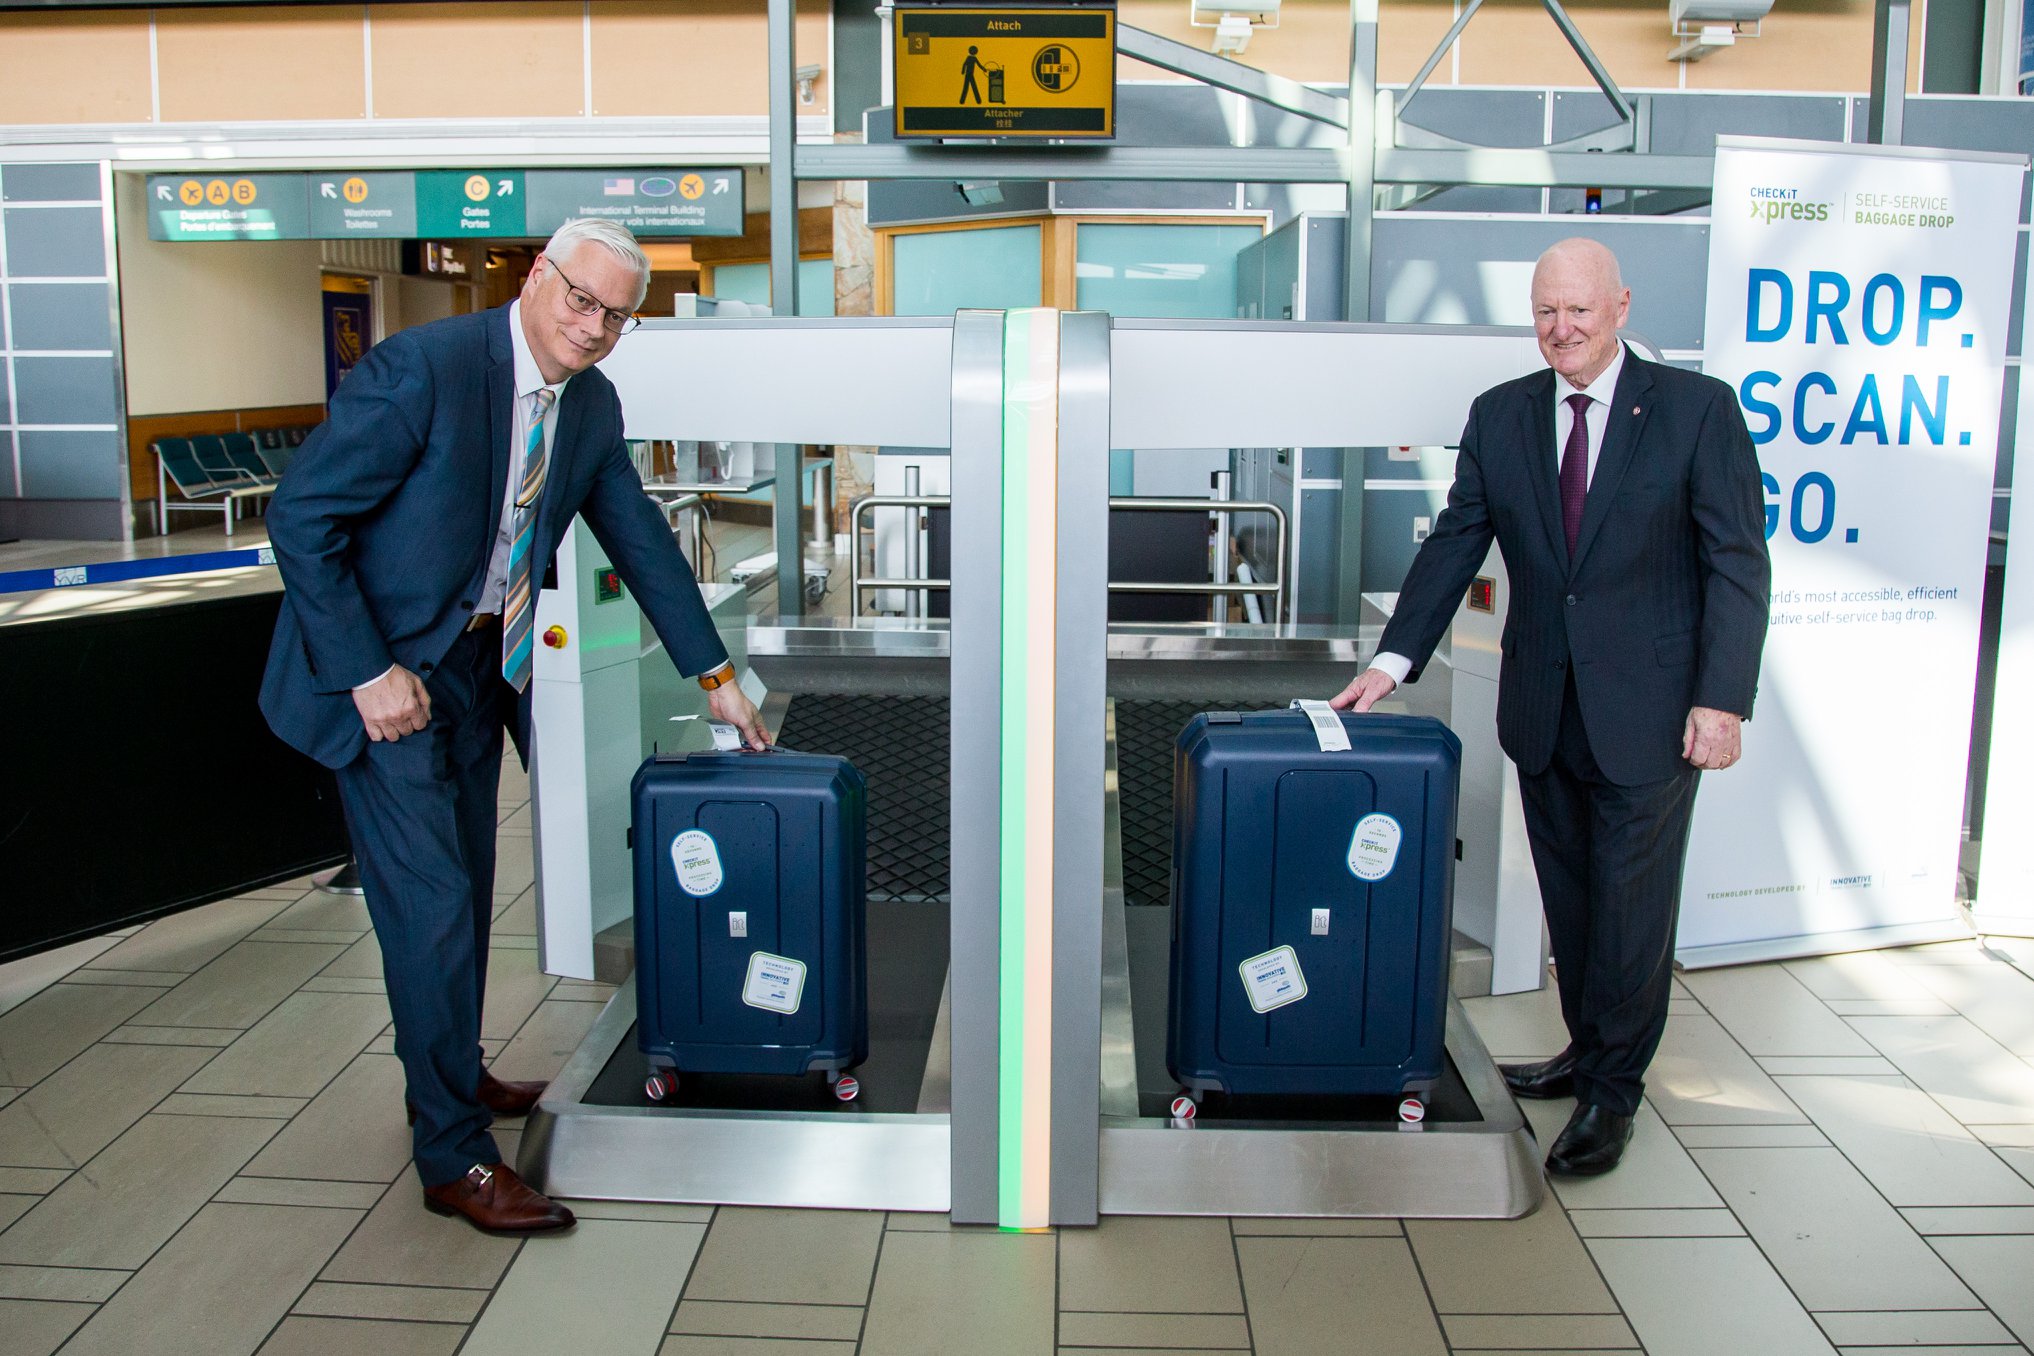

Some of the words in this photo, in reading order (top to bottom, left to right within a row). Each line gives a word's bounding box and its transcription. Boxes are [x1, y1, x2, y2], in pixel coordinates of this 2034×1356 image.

[987, 20, 1021, 31] Attach
[915, 38, 923, 49] 3
[984, 109, 1024, 118] Attacher
[212, 185, 224, 200] A
[238, 185, 250, 200] B
[470, 180, 483, 195] C
[1855, 193, 1948, 211] SELF-SERVICE
[344, 208, 393, 217] Washrooms
[462, 207, 490, 217] Gates
[579, 205, 631, 215] International
[634, 205, 668, 215] Terminal
[670, 205, 706, 217] Building
[345, 219, 379, 229] Toilettes
[461, 219, 490, 229] Portes
[626, 218, 644, 226] vols
[645, 217, 705, 226] internationaux
[1855, 211, 1915, 227] BAGGAGE
[1919, 214, 1954, 228] DROP
[1745, 268, 1974, 347] DROP.
[1740, 371, 1972, 445] SCAN.
[1770, 590, 1801, 604] orld's
[1805, 590, 1837, 603] most
[1841, 587, 1904, 603] accessible,
[1907, 586, 1958, 600] efficient
[1770, 612, 1803, 626] uitive
[1806, 610, 1878, 625] self-service
[1881, 608, 1902, 624] bag
[1905, 607, 1937, 623] drop.
[1830, 875, 1873, 886] INNOVATIVE
[1706, 889, 1753, 900] TECHNOLOGY
[1754, 885, 1796, 896] DEVELOPED
